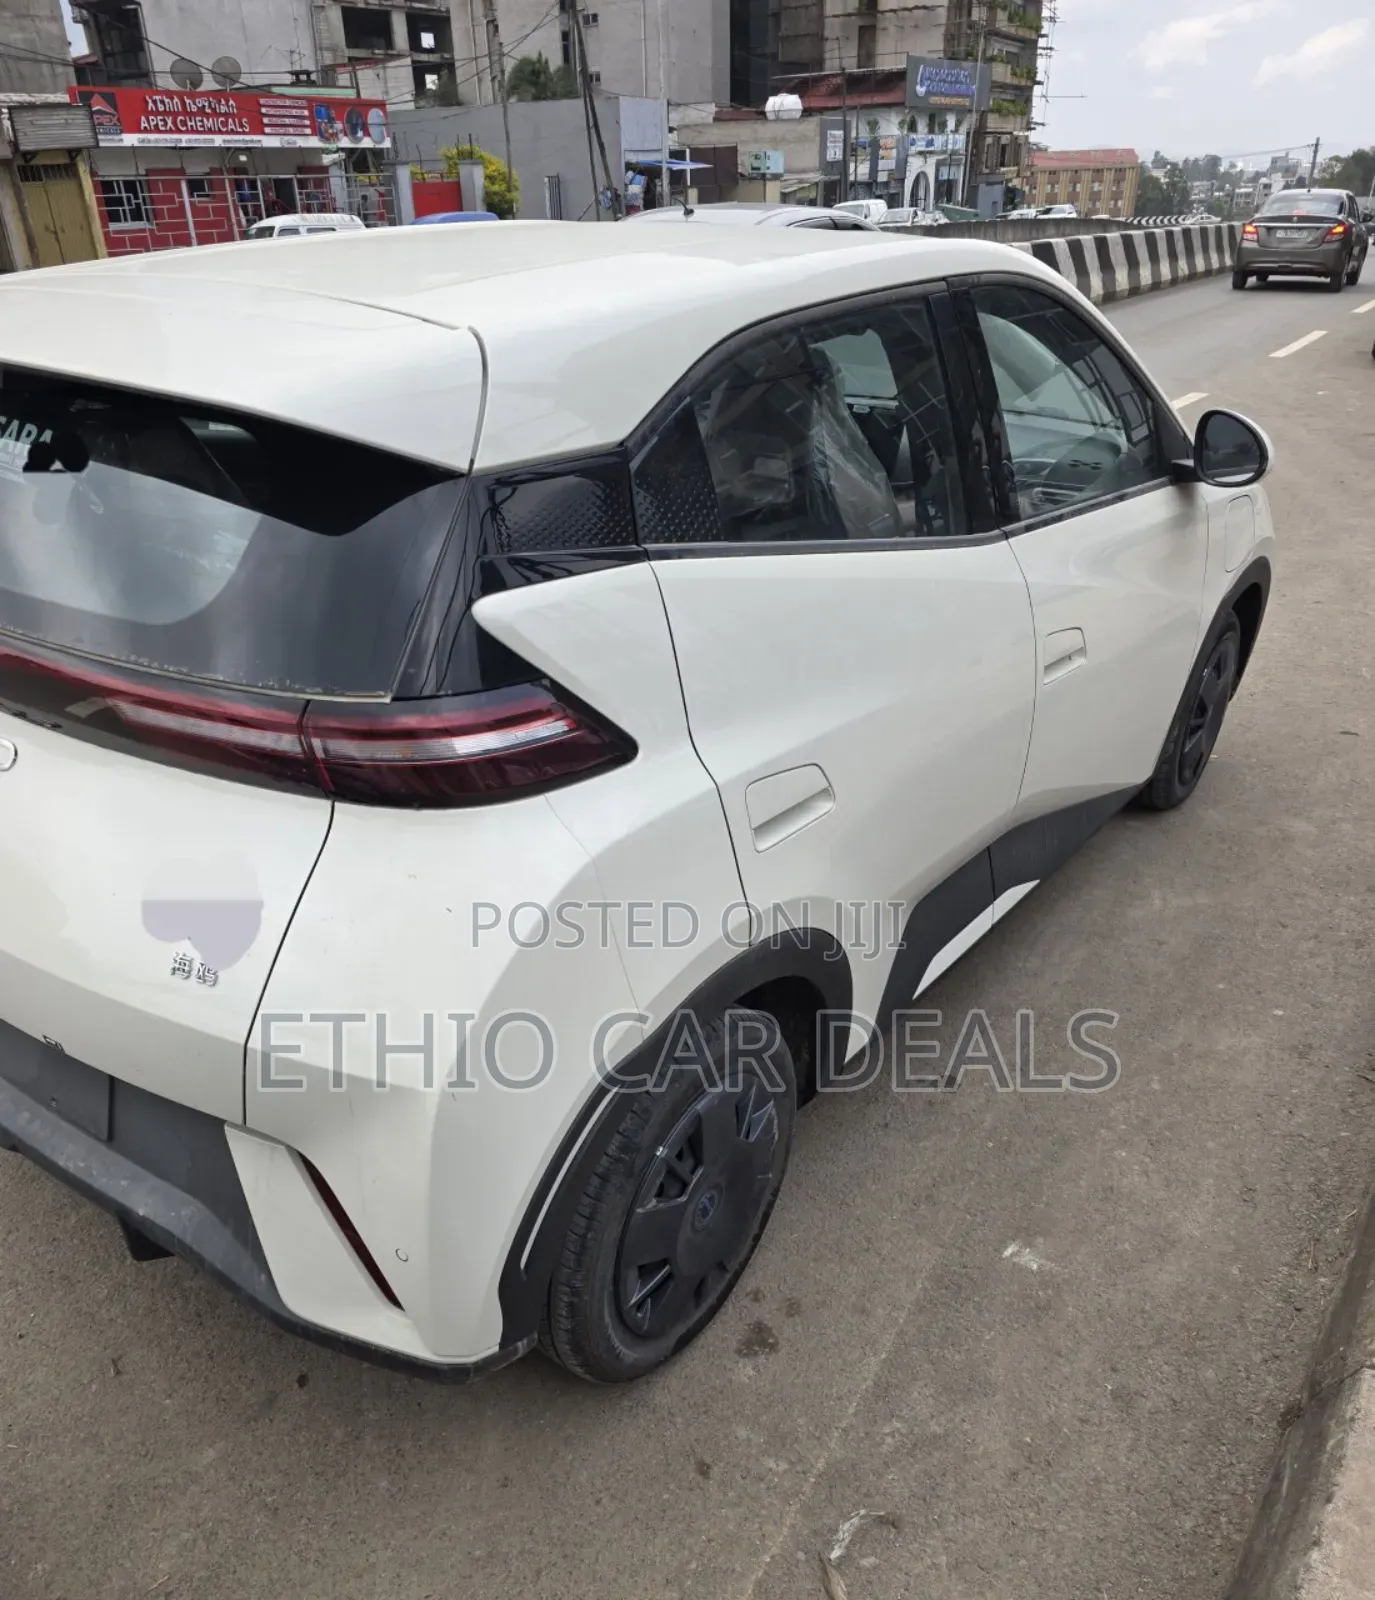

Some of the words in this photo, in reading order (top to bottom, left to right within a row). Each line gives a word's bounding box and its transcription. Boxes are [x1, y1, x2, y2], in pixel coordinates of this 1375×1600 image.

[140, 115, 175, 131] APEX
[177, 116, 249, 132] CHEMICALS
[170, 950, 219, 988] 海鸥
